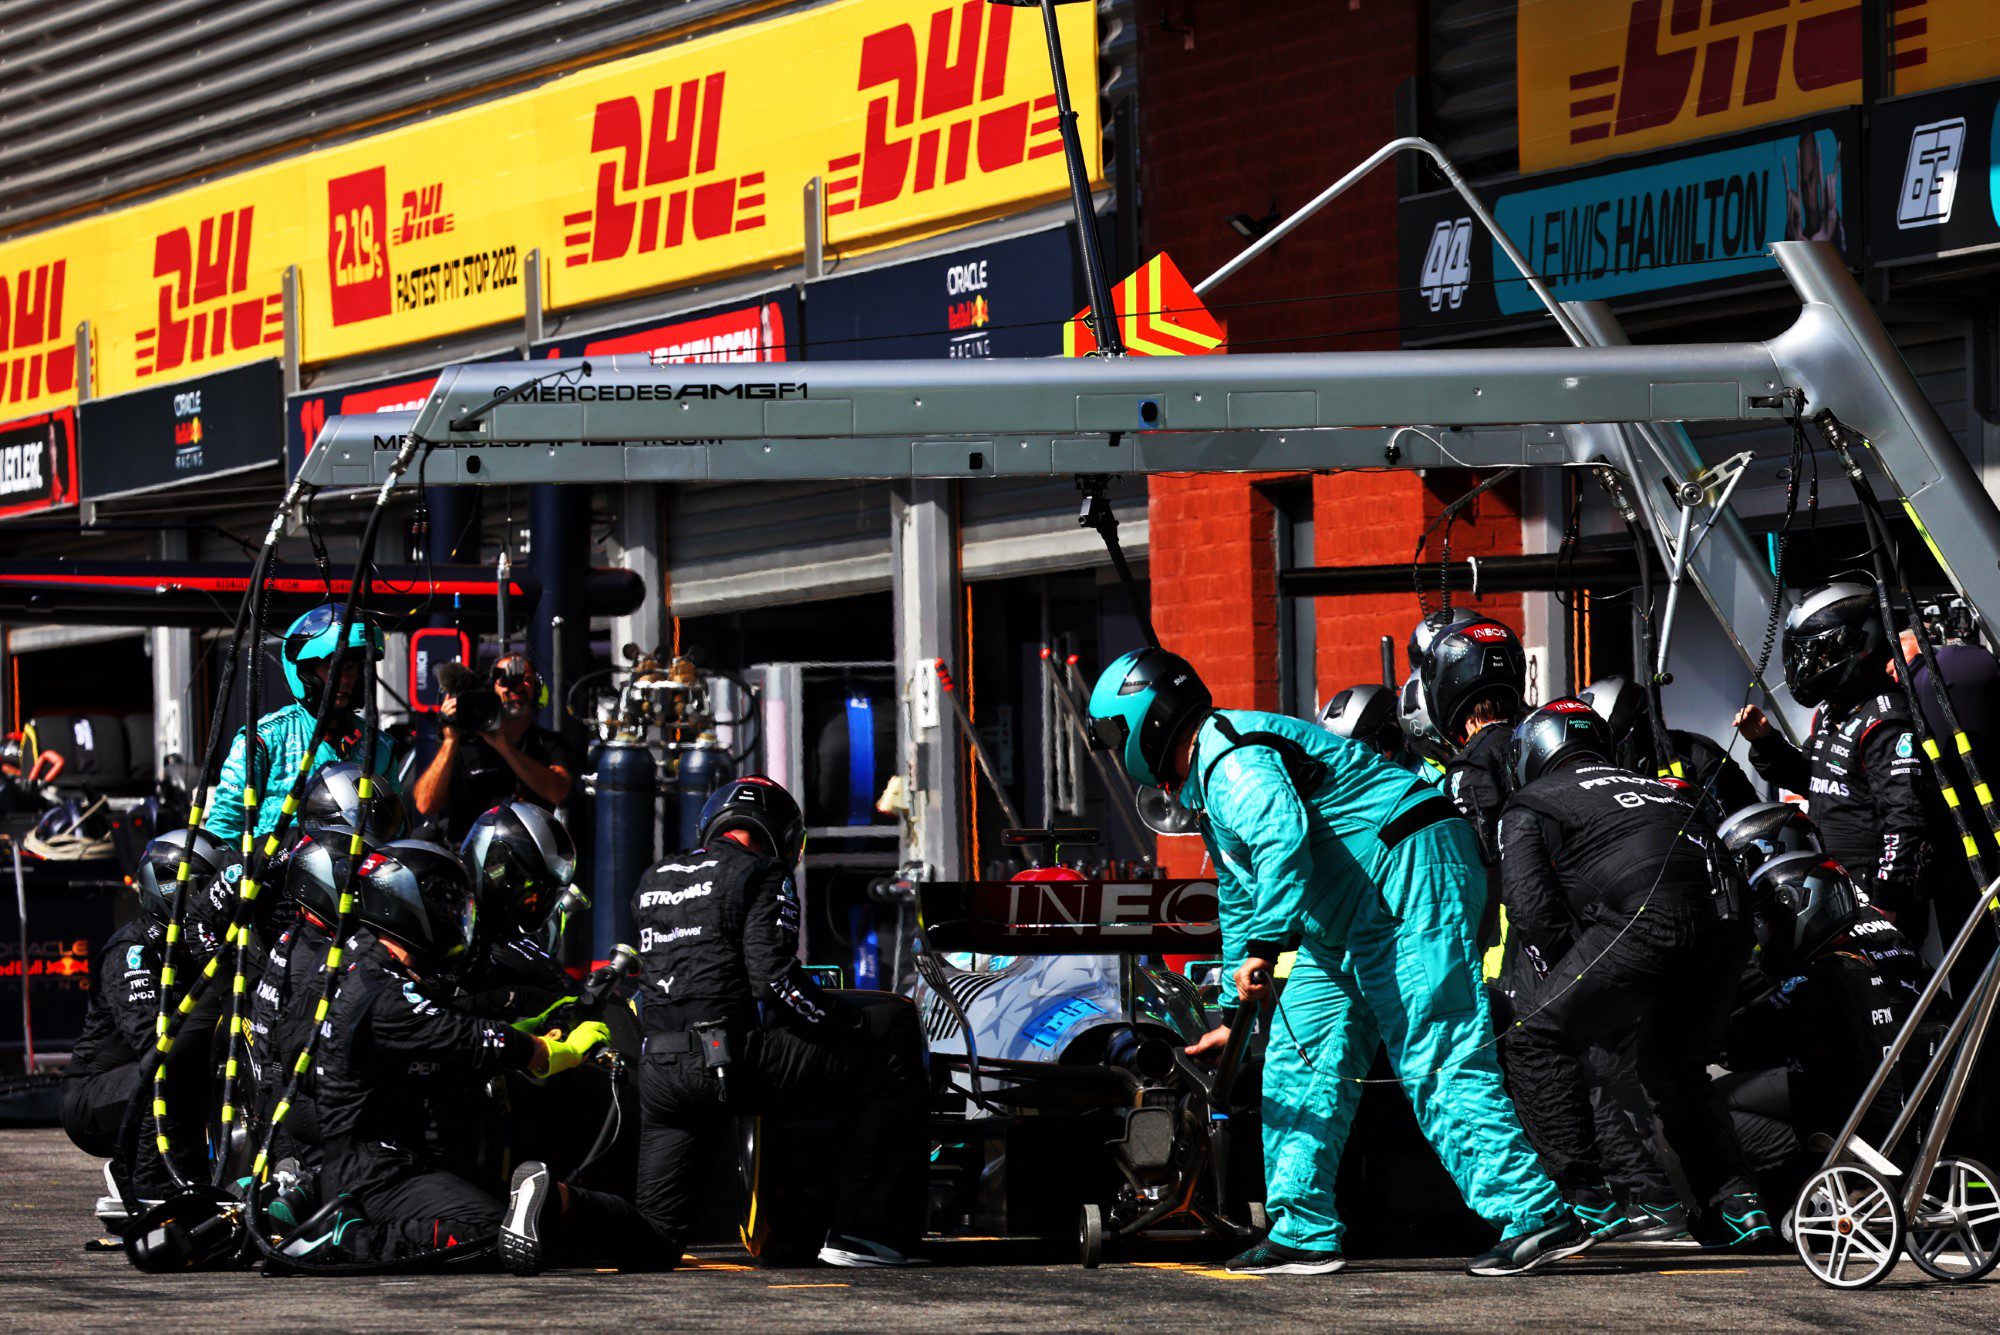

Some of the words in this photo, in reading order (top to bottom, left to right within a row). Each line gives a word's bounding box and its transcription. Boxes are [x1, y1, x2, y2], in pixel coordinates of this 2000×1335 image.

[859, 0, 1030, 209] DHL
[592, 71, 736, 262] DHL
[1897, 117, 1967, 229] 63
[401, 183, 445, 243] DHL
[1527, 201, 1611, 291] LEWIS
[1614, 169, 1768, 277] HAMILTON
[153, 206, 264, 371] DHL
[397, 264, 440, 311] FASTEST
[443, 259, 460, 302] PIT
[463, 252, 489, 296] STOP
[492, 245, 517, 289] 2022
[947, 261, 988, 296] ORACLE
[1420, 217, 1473, 313] 44
[1473, 627, 1507, 638] INEOS
[654, 925, 703, 944] TeamViewer
[1002, 882, 1221, 936] INEO
[130, 979, 149, 989] IWC
[769, 976, 826, 1024] INEOS
